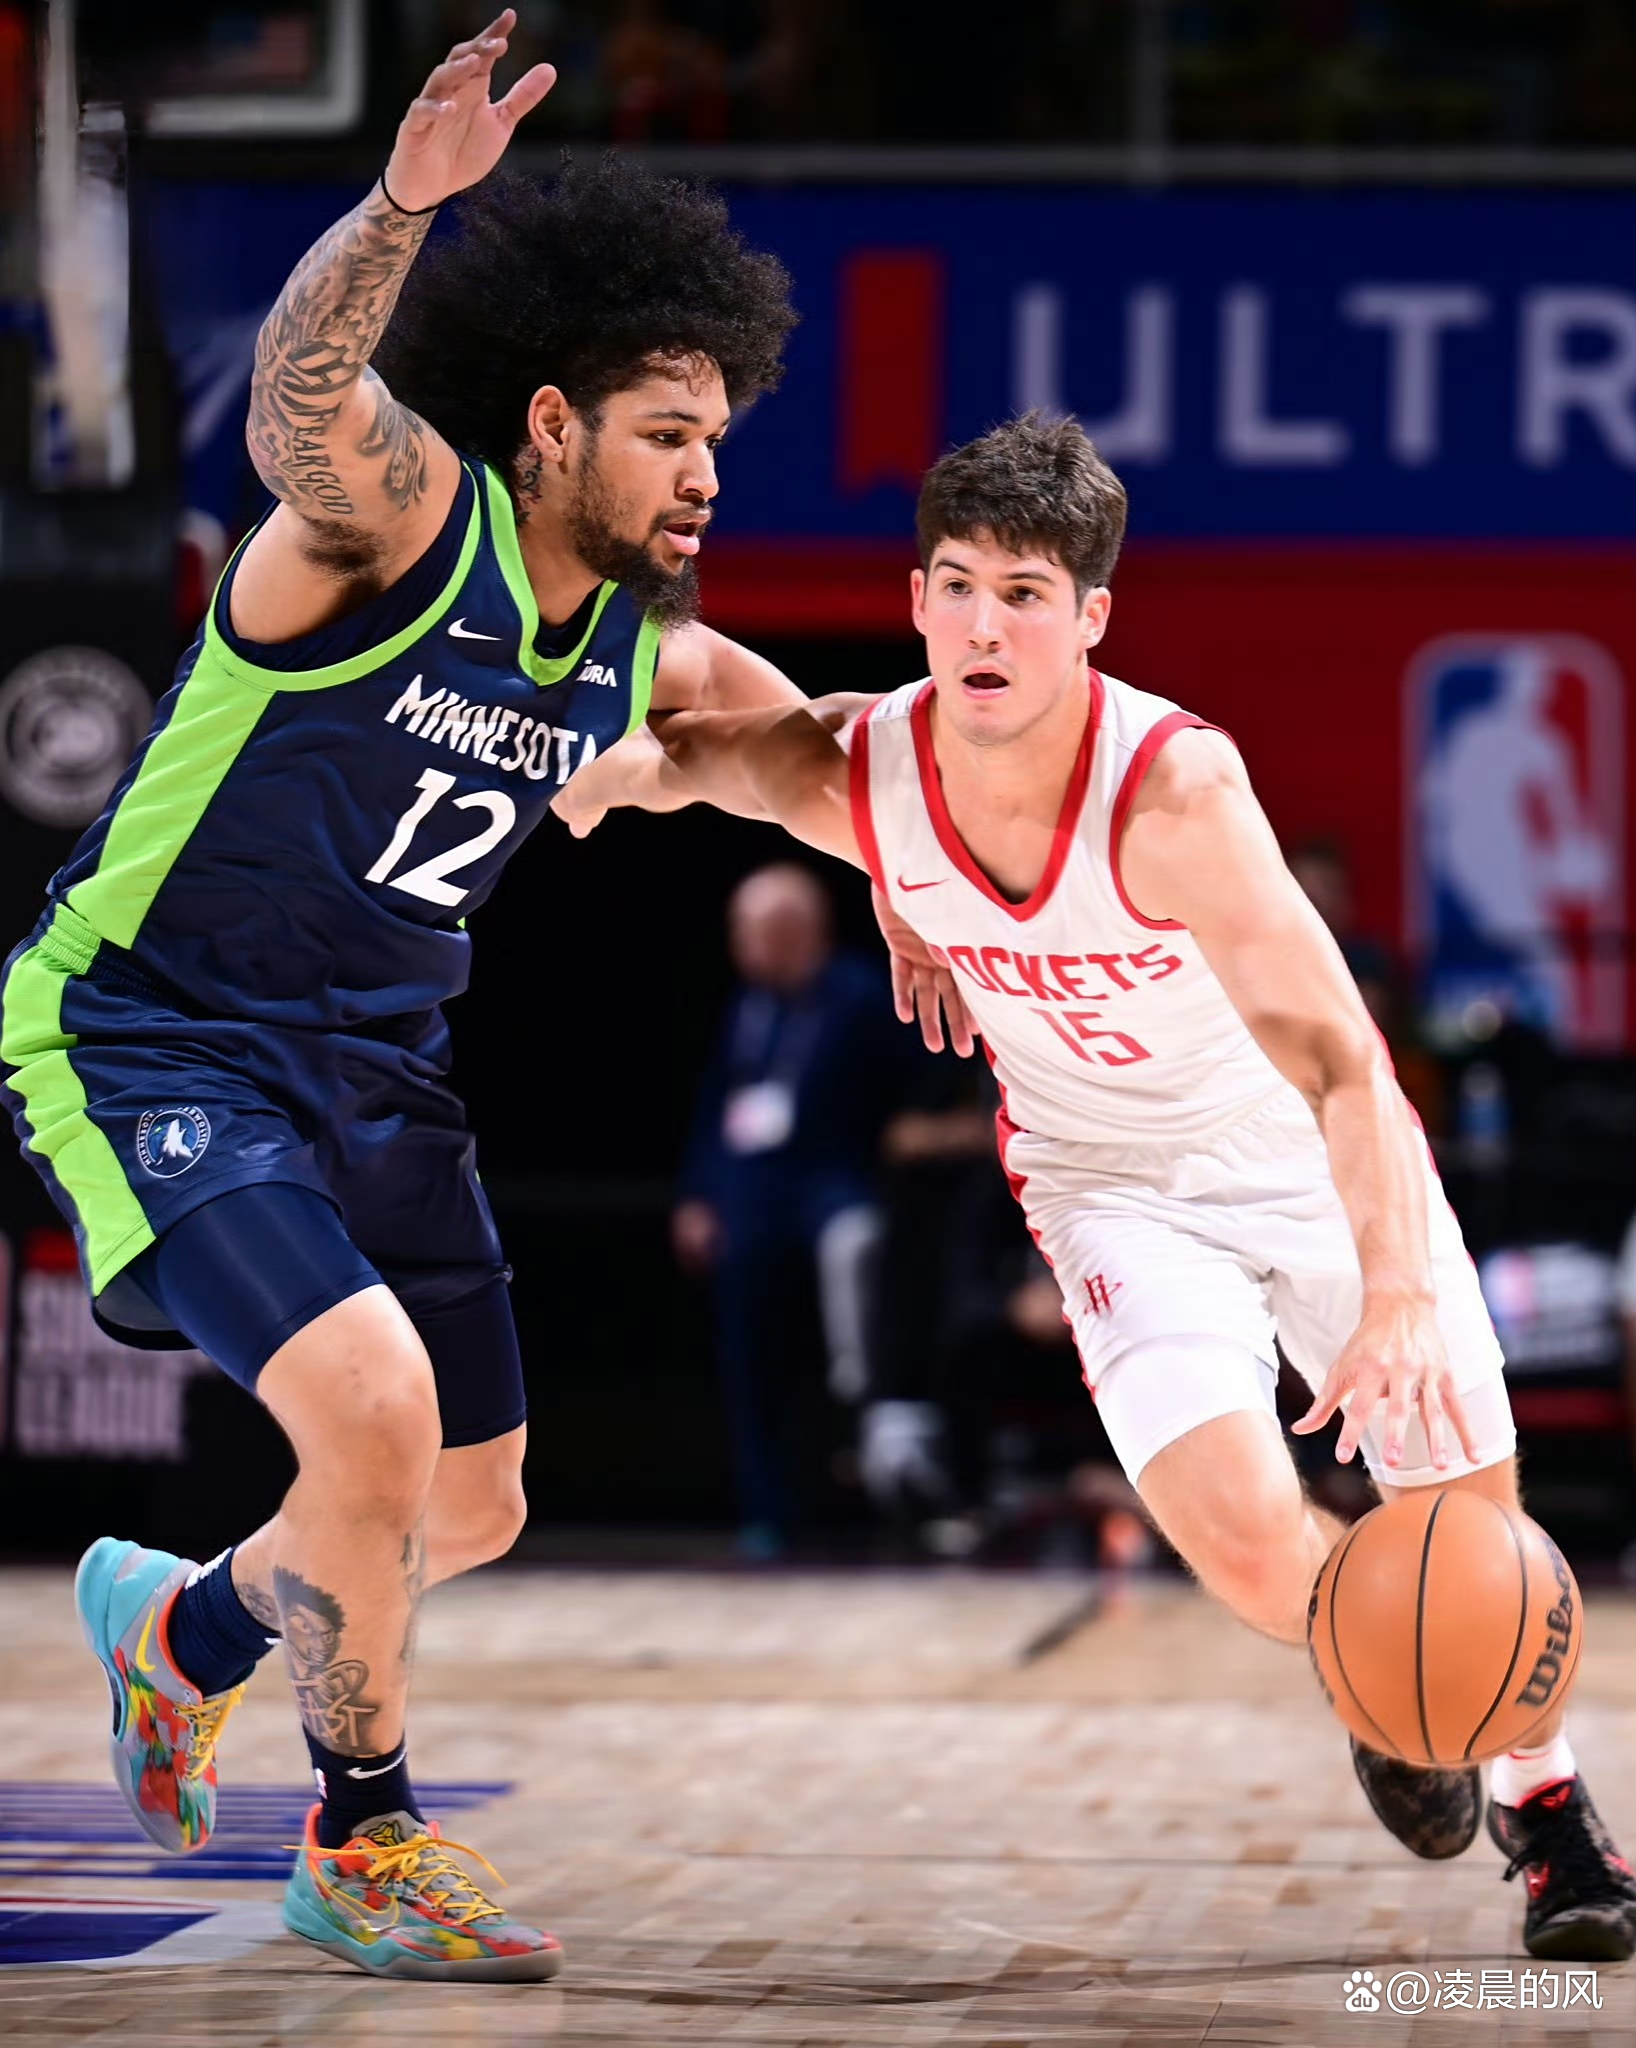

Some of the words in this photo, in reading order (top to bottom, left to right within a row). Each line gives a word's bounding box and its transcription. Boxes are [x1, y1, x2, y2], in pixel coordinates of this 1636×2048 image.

[1011, 284, 1636, 468] ULTR
[286, 401, 342, 467] FEAR
[288, 470, 354, 515] GOD
[363, 767, 516, 907] 12
[927, 943, 1184, 1001] OCKETS
[1027, 1006, 1154, 1067] 15
